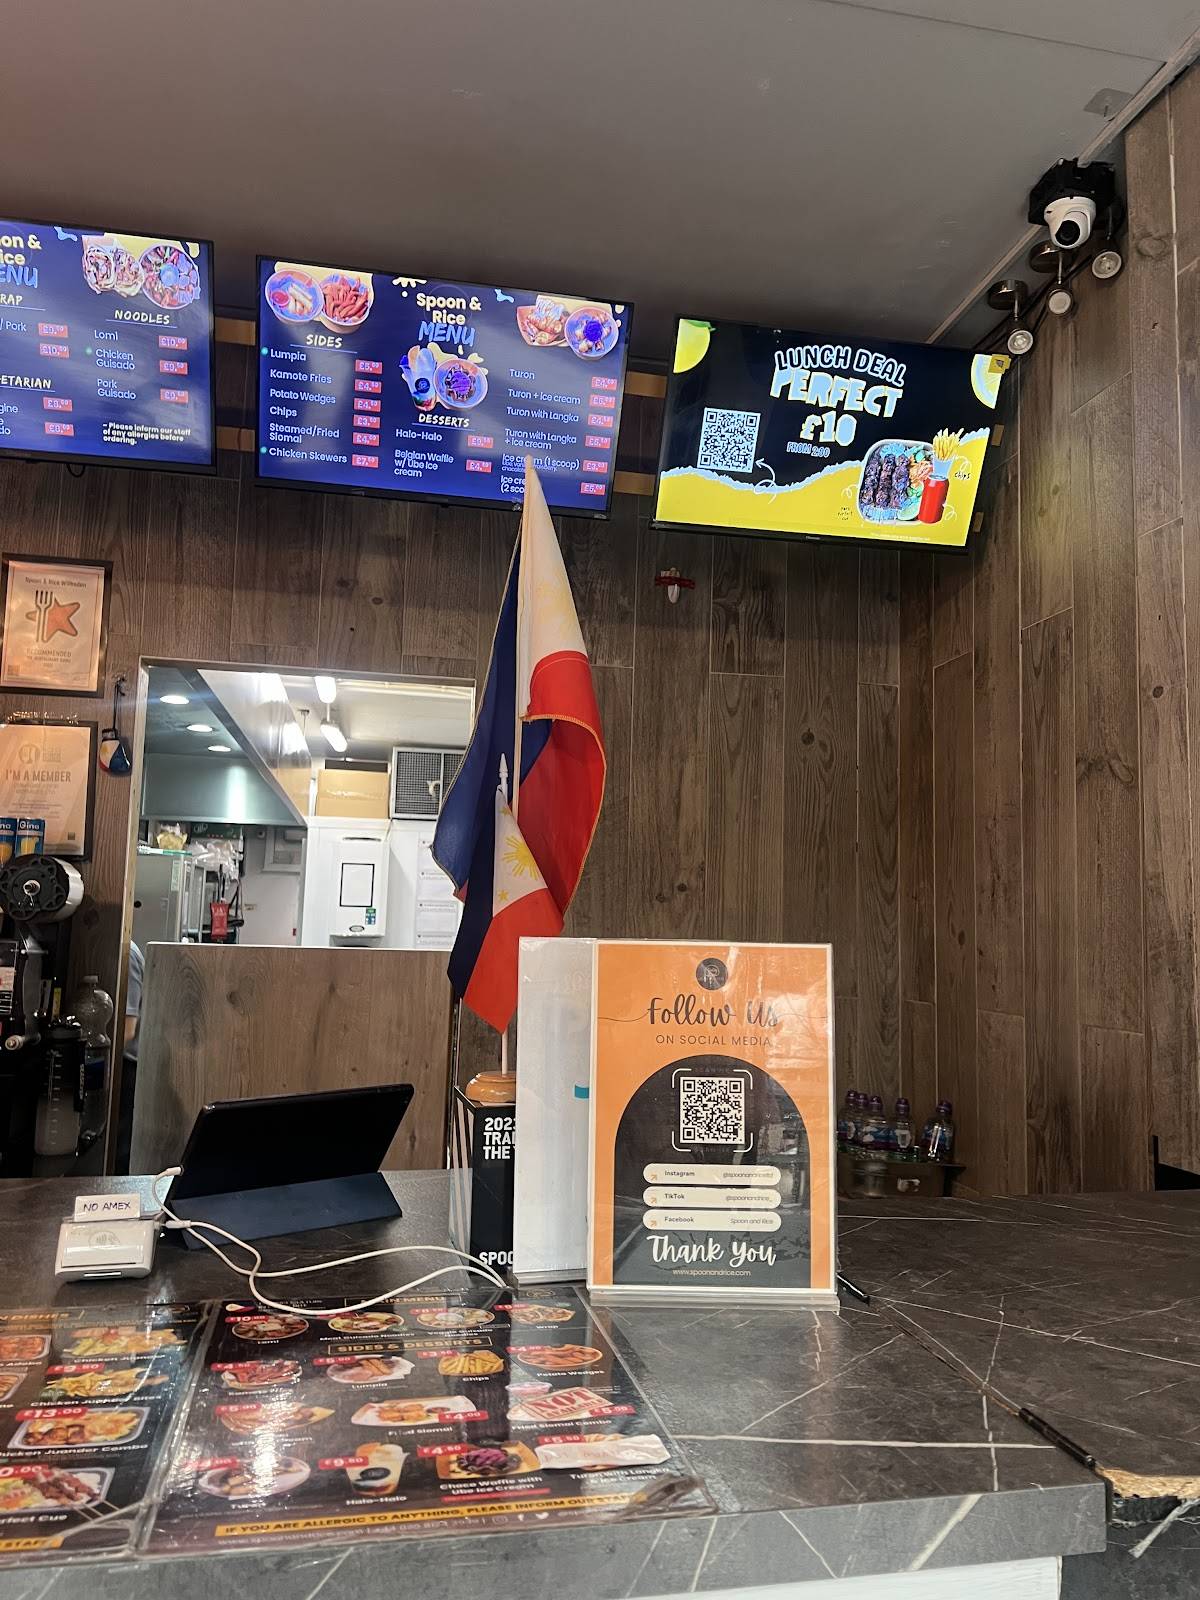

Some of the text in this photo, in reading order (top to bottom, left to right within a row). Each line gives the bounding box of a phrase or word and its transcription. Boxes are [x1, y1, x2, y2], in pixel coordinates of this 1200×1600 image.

[0, 234, 42, 250] on &
[0, 294, 22, 306] RAP
[416, 292, 482, 312] Spoon &
[115, 310, 170, 325] NOODLES
[432, 309, 466, 326] Rice
[6, 321, 26, 332] Pork
[418, 320, 476, 347] MENU
[306, 334, 342, 348] SIDES
[96, 349, 134, 360] Chicken
[270, 348, 306, 362] Lumpia
[96, 359, 135, 370] Guisado
[774, 344, 906, 387] LUNCH DEAL
[270, 369, 332, 384] Kamote Fries
[510, 368, 534, 380] Turon
[0, 375, 51, 389] ETARIAN
[97, 379, 117, 389] Pork
[98, 388, 136, 400] Guisado
[270, 388, 336, 404] Potato Wedges
[508, 388, 532, 400] Turon
[540, 392, 552, 400] Ice
[554, 395, 580, 404] cream
[770, 367, 904, 418] PERFECT
[270, 406, 297, 418] Chips
[506, 406, 579, 423] Turon with Langka
[419, 414, 470, 428] DESSERTS
[108, 422, 134, 432] Please
[134, 424, 159, 434] inform
[174, 428, 190, 436] staff
[270, 423, 340, 438] Steamed/Fried
[800, 410, 858, 446] £10
[112, 430, 126, 438] any
[127, 430, 160, 441] allergies
[160, 433, 184, 442] before
[396, 429, 442, 442] Halo-Halo
[505, 428, 576, 444] Turon with Langka
[512, 438, 524, 446] Ice
[524, 440, 552, 450] cream
[786, 442, 812, 455] FROM
[269, 448, 348, 463] Chicken Skewers
[394, 450, 454, 463] Belgian Waffle
[394, 458, 438, 470] w/ Ube Ice
[502, 454, 514, 462] Ice
[516, 455, 542, 465] crm
[552, 459, 580, 471] scoop)
[394, 468, 422, 478] cream
[500, 475, 513, 484] Ice
[500, 482, 509, 494] (2
[6, 769, 71, 782] I'M A MEMBER
[20, 820, 40, 830] Gina
[648, 994, 778, 1026] Follow Us
[656, 1034, 770, 1046] ON SOCIAL MEDIA
[484, 1117, 515, 1130] 202
[482, 1146, 510, 1160] THE
[664, 1170, 694, 1178] Instagram
[84, 1202, 131, 1212] NO AMEX
[646, 1235, 776, 1268] Thank You
[24, 1408, 82, 1418] £13.00
[102, 1444, 148, 1452] Combo
[440, 1476, 543, 1490] Choco Waffle with
[452, 1488, 474, 1496] Ube
[492, 1484, 534, 1492] Cream
[346, 1495, 407, 1506] Halo-Halo
[226, 1526, 238, 1534] IF
[242, 1524, 270, 1532] YOU
[274, 1522, 298, 1530] ARE
[304, 1516, 366, 1527] ALLERGIC
[371, 1514, 387, 1522] TO
[390, 1508, 464, 1519] ANYTHING,
[466, 1504, 512, 1514] PLEASE
[516, 1500, 564, 1510] INFORM
